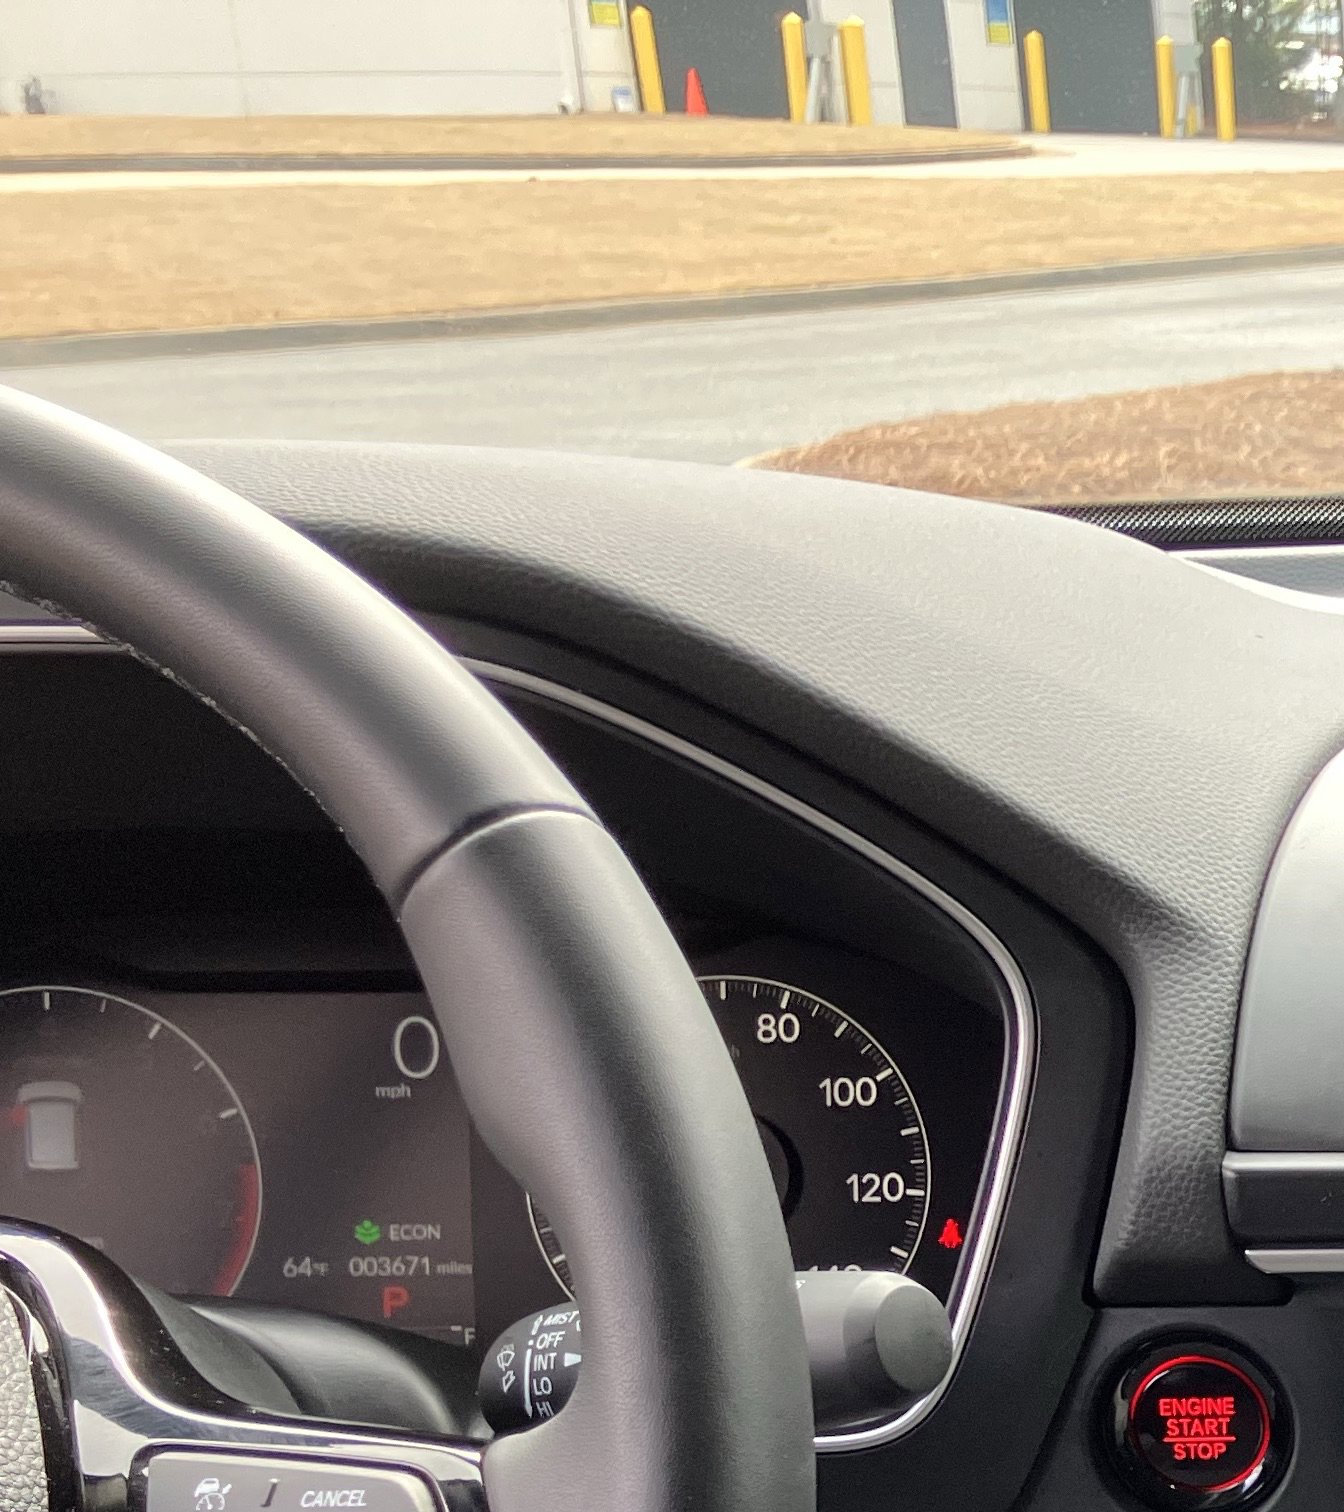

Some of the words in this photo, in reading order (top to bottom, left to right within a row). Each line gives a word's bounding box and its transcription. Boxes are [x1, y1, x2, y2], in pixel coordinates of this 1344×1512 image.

[756, 1012, 800, 1044] 80
[393, 1015, 440, 1080] 0
[374, 1083, 412, 1099] mph
[818, 1076, 878, 1107] 100
[846, 1171, 905, 1204] 120
[389, 1223, 441, 1242] ECON
[348, 1255, 430, 1277] 003671
[436, 1260, 473, 1275] miles
[382, 1284, 412, 1319] P
[464, 1327, 476, 1345] F
[536, 1331, 565, 1350] OFF
[533, 1352, 557, 1371] INT
[533, 1376, 552, 1396] LO
[535, 1401, 554, 1417] HI
[1158, 1396, 1236, 1416] ENGINE
[1166, 1416, 1231, 1437] START
[1173, 1443, 1227, 1460] STOP
[300, 1489, 367, 1508] CANCEL
